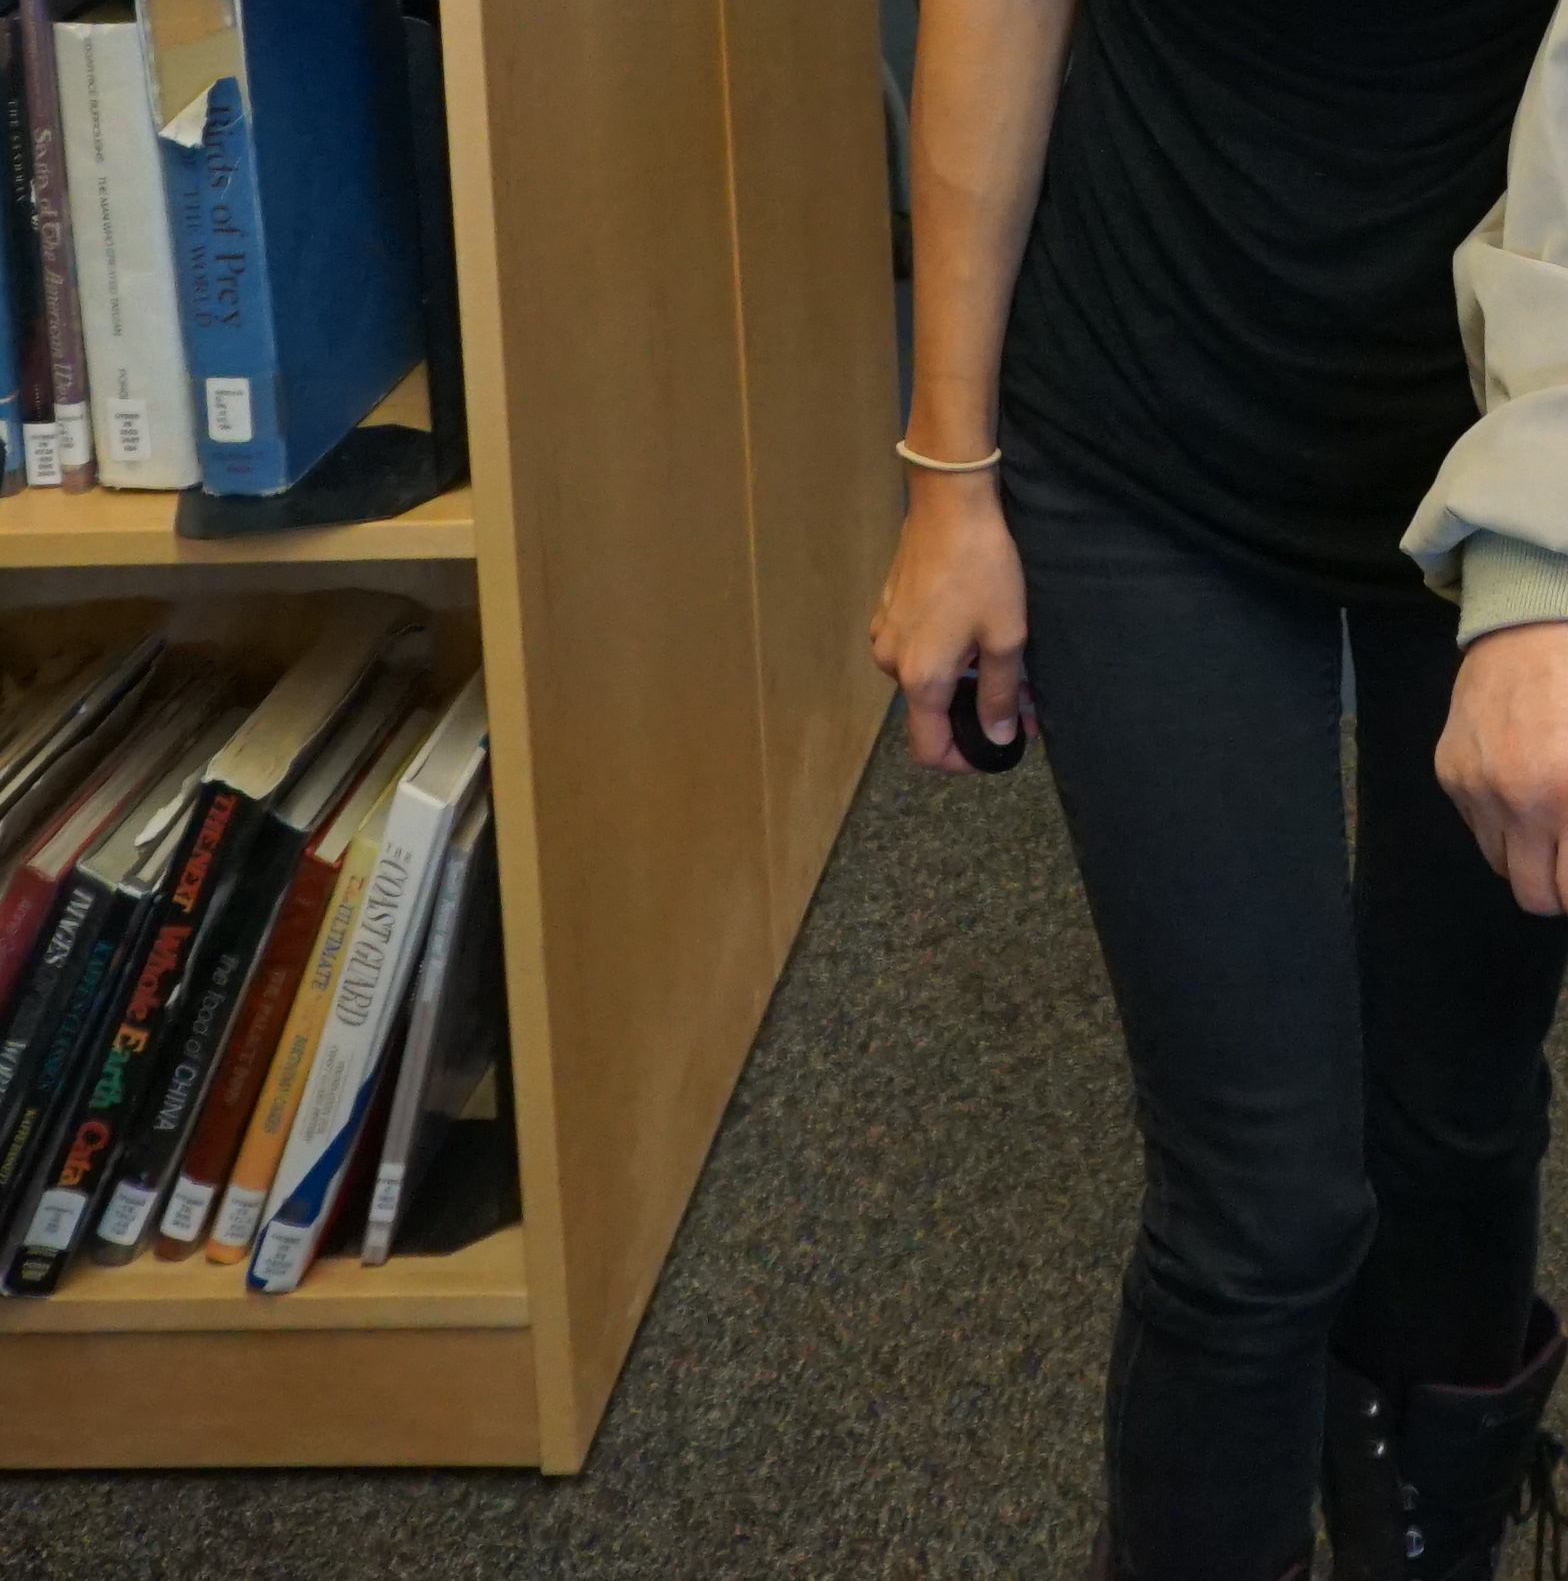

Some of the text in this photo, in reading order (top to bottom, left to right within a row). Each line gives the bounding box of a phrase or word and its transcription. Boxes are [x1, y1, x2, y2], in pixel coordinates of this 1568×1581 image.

[211, 206, 245, 235] of
[211, 252, 248, 329] Prey
[55, 362, 73, 405] Wes
[196, 793, 238, 848] THE
[170, 846, 222, 915] NEXT
[359, 859, 409, 944] COAST
[127, 926, 193, 1022] Whole
[311, 903, 355, 992] ULTIMATE
[334, 941, 386, 1027] GUARD
[88, 1021, 151, 1111] Earth
[153, 954, 240, 1131] the food of CHINA
[58, 1120, 113, 1188] Cata
